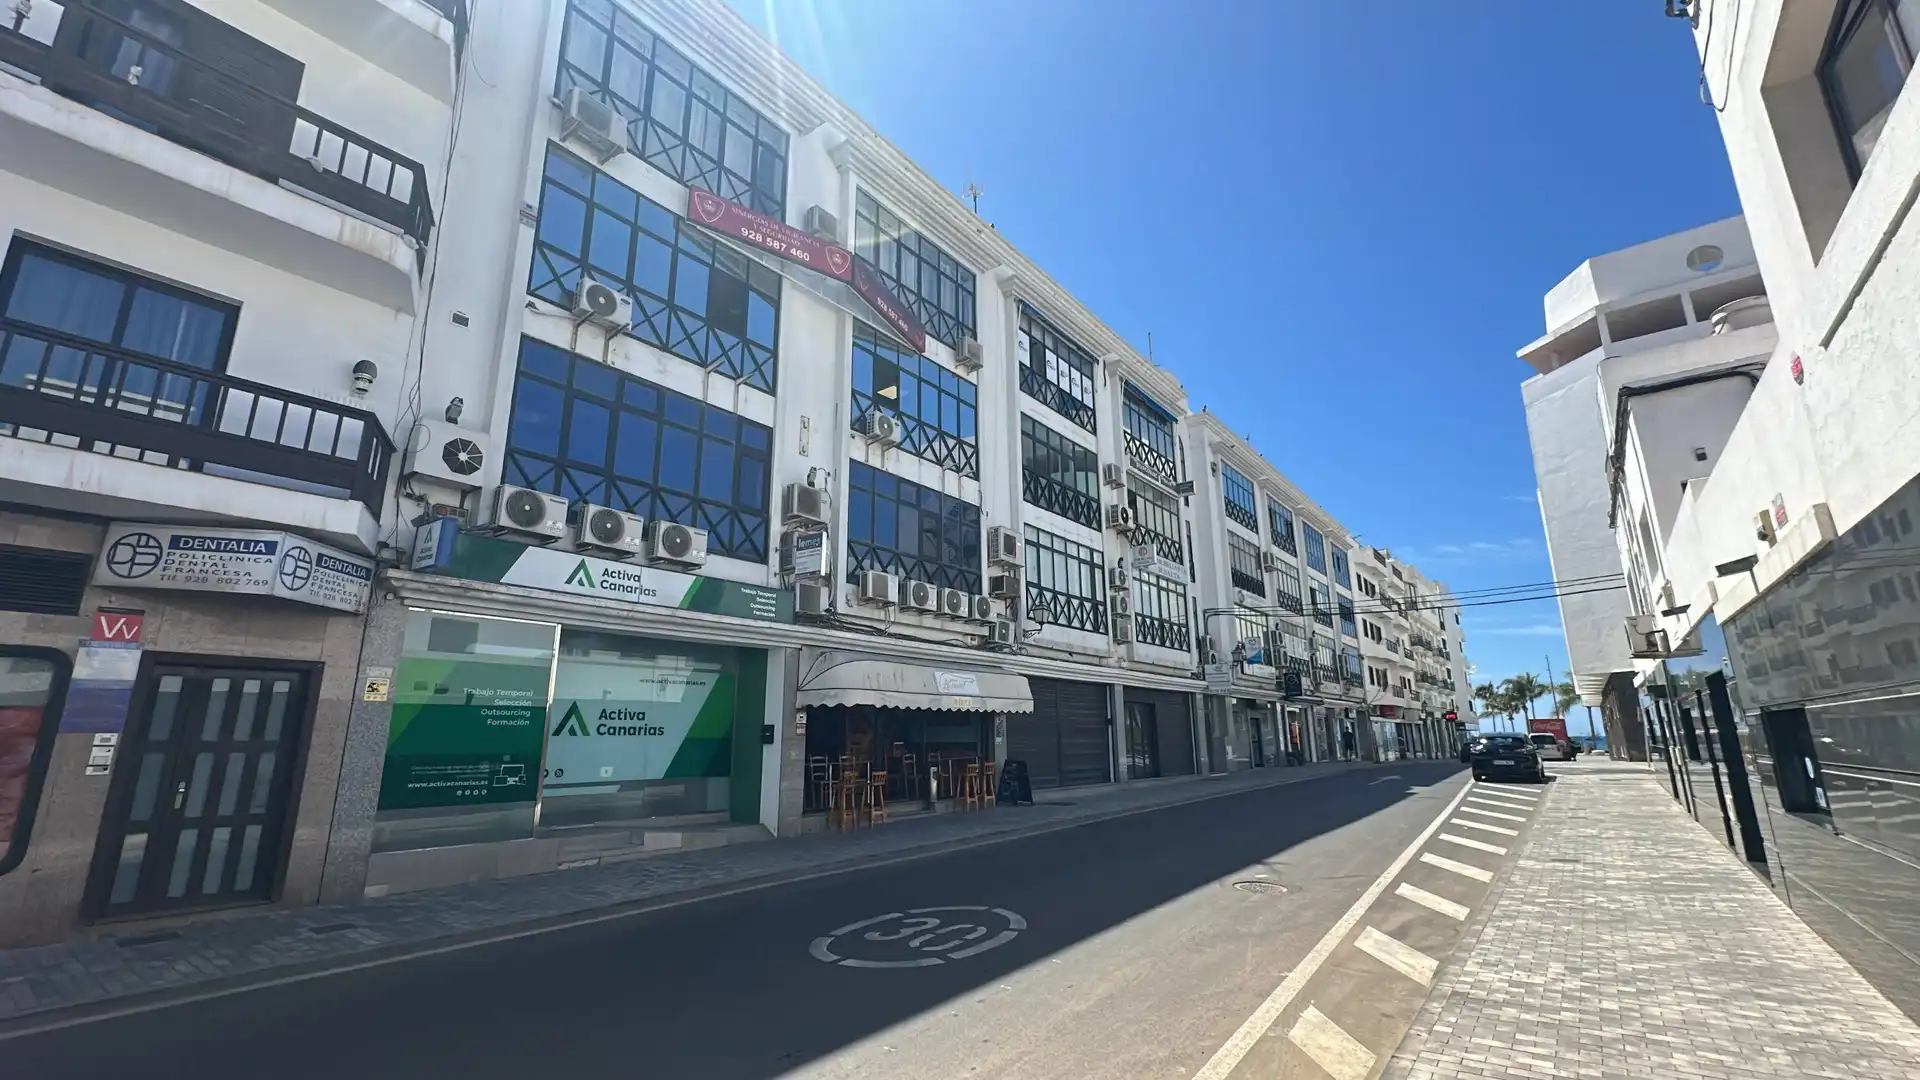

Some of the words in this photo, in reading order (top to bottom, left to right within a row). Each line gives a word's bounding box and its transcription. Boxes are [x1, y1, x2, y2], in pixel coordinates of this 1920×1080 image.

[741, 227, 763, 243] 928
[766, 237, 788, 252] 587
[790, 247, 810, 262] 460
[179, 537, 267, 553] DENTALIA
[164, 558, 229, 569] DENTAL
[166, 551, 273, 564] POLICLINICA
[161, 567, 253, 577] FRANCESA
[321, 556, 366, 578] DENTALIA
[184, 575, 208, 584] 928
[216, 576, 241, 586] 802
[244, 578, 269, 587] 769
[311, 574, 346, 589] DENTAL
[313, 568, 369, 587] POLICLINICA
[602, 567, 640, 583] Activa
[311, 581, 358, 598] FRANCESA
[600, 579, 657, 597] Canarias
[463, 687, 494, 697] Trabajo
[496, 688, 533, 697] Temporal
[493, 698, 532, 707] Selección
[480, 708, 531, 717] Outsourcing
[598, 708, 646, 721] Activa
[486, 718, 530, 726] Formación
[596, 723, 665, 737] Canarias
[407, 779, 489, 788] www.activacanarias.es
[864, 917, 987, 951] 30
